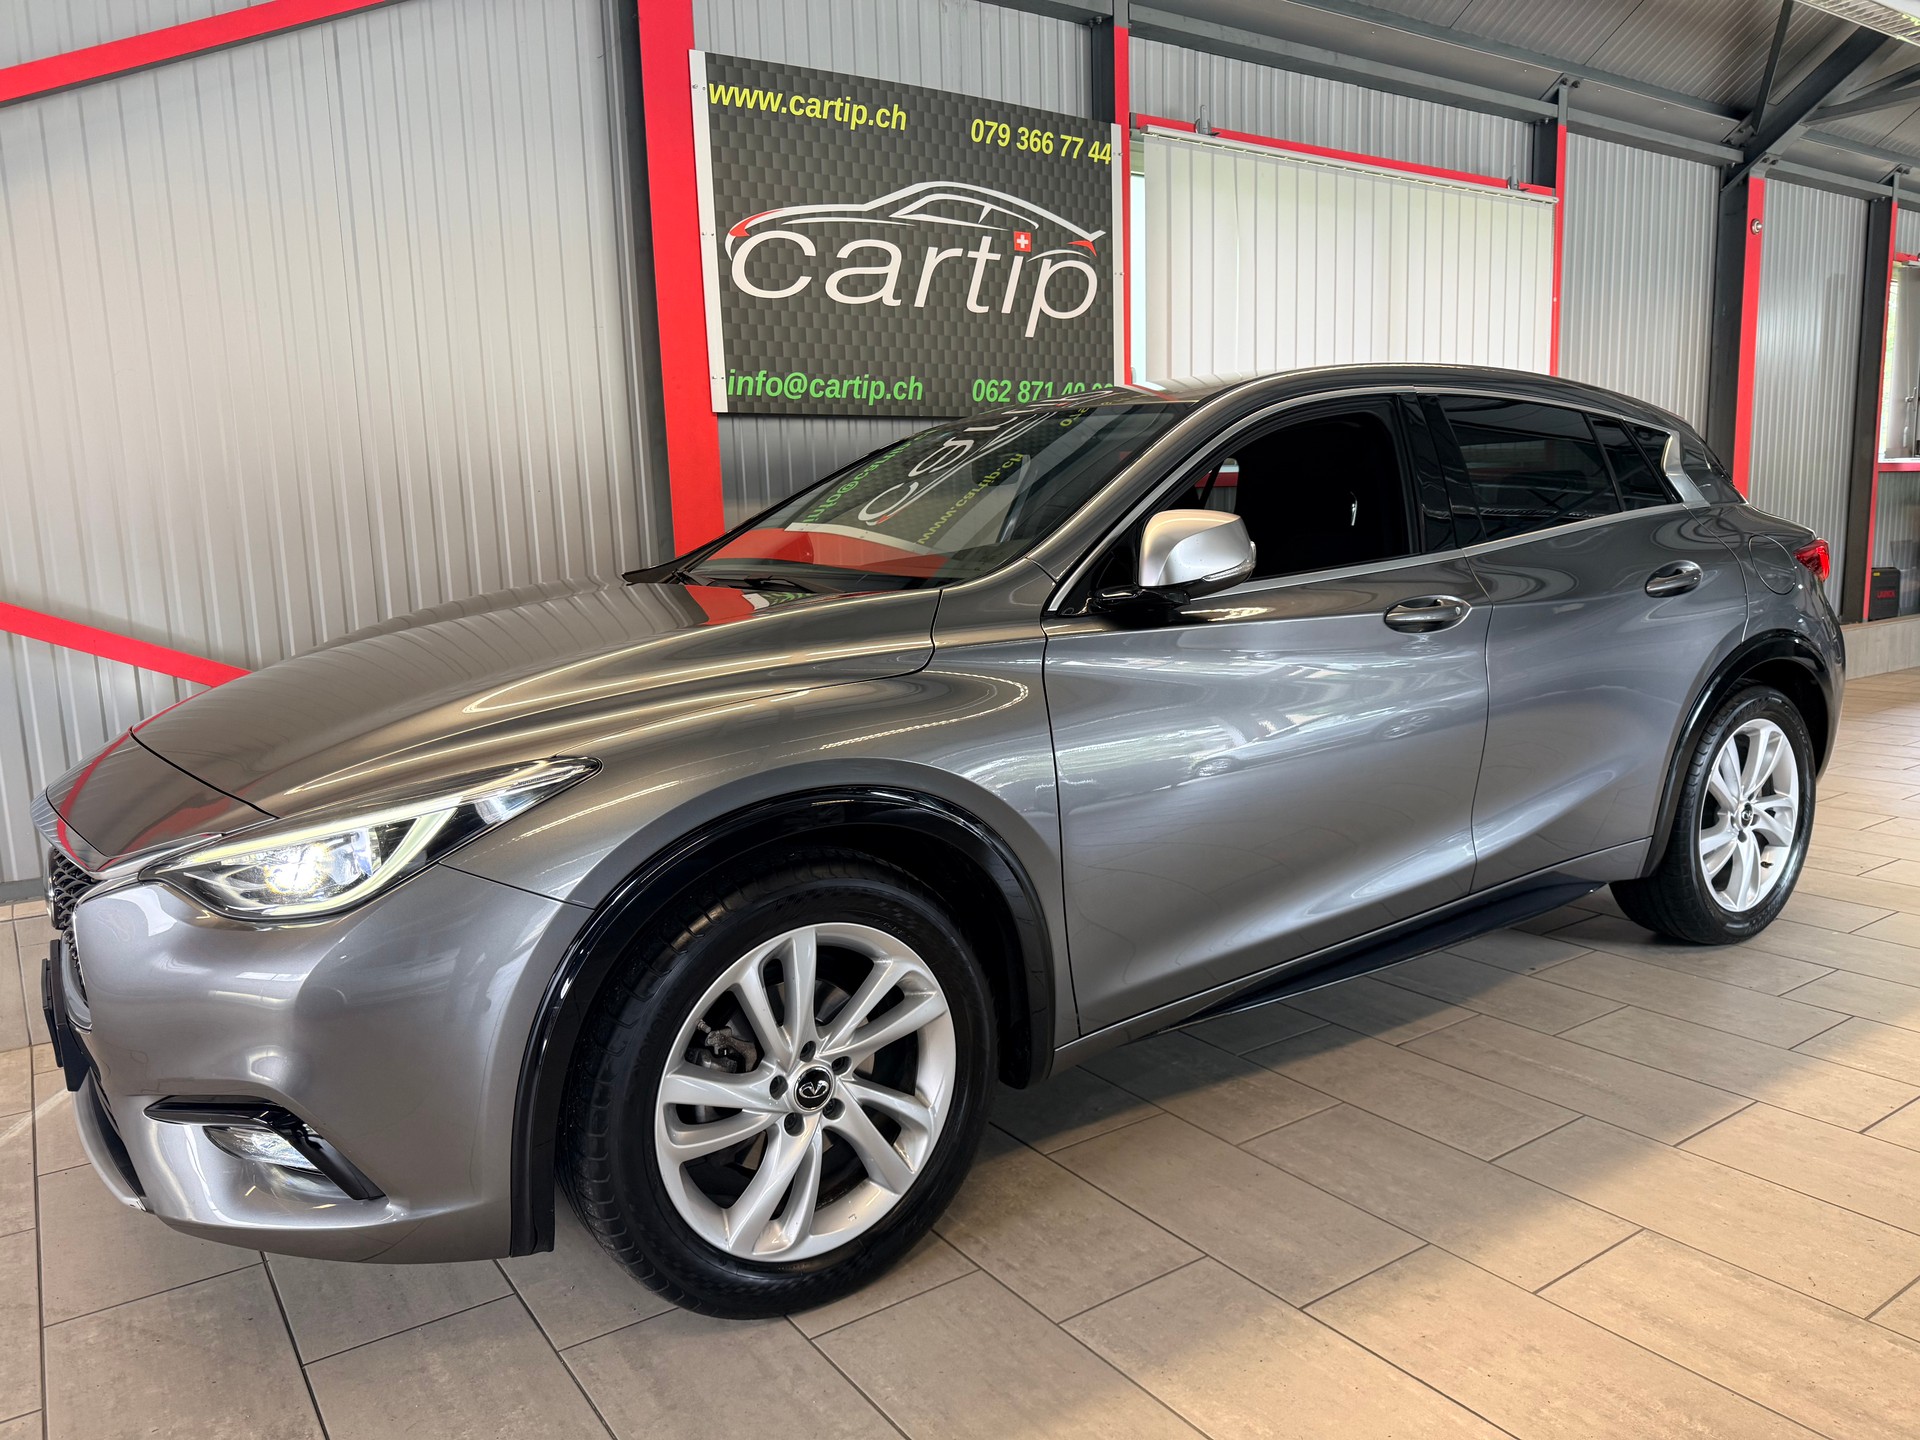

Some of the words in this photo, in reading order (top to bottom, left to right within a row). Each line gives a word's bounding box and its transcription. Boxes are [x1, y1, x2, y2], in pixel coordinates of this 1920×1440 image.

[708, 82, 908, 131] www.cartip.ch
[971, 119, 1011, 147] 079
[1017, 127, 1054, 154] 366
[1061, 135, 1084, 159] 77
[1089, 141, 1111, 164] 44
[731, 229, 1098, 338] cartip
[727, 369, 924, 406] info@cartip.ch
[972, 378, 1012, 404] 062
[1017, 380, 1054, 404] 871
